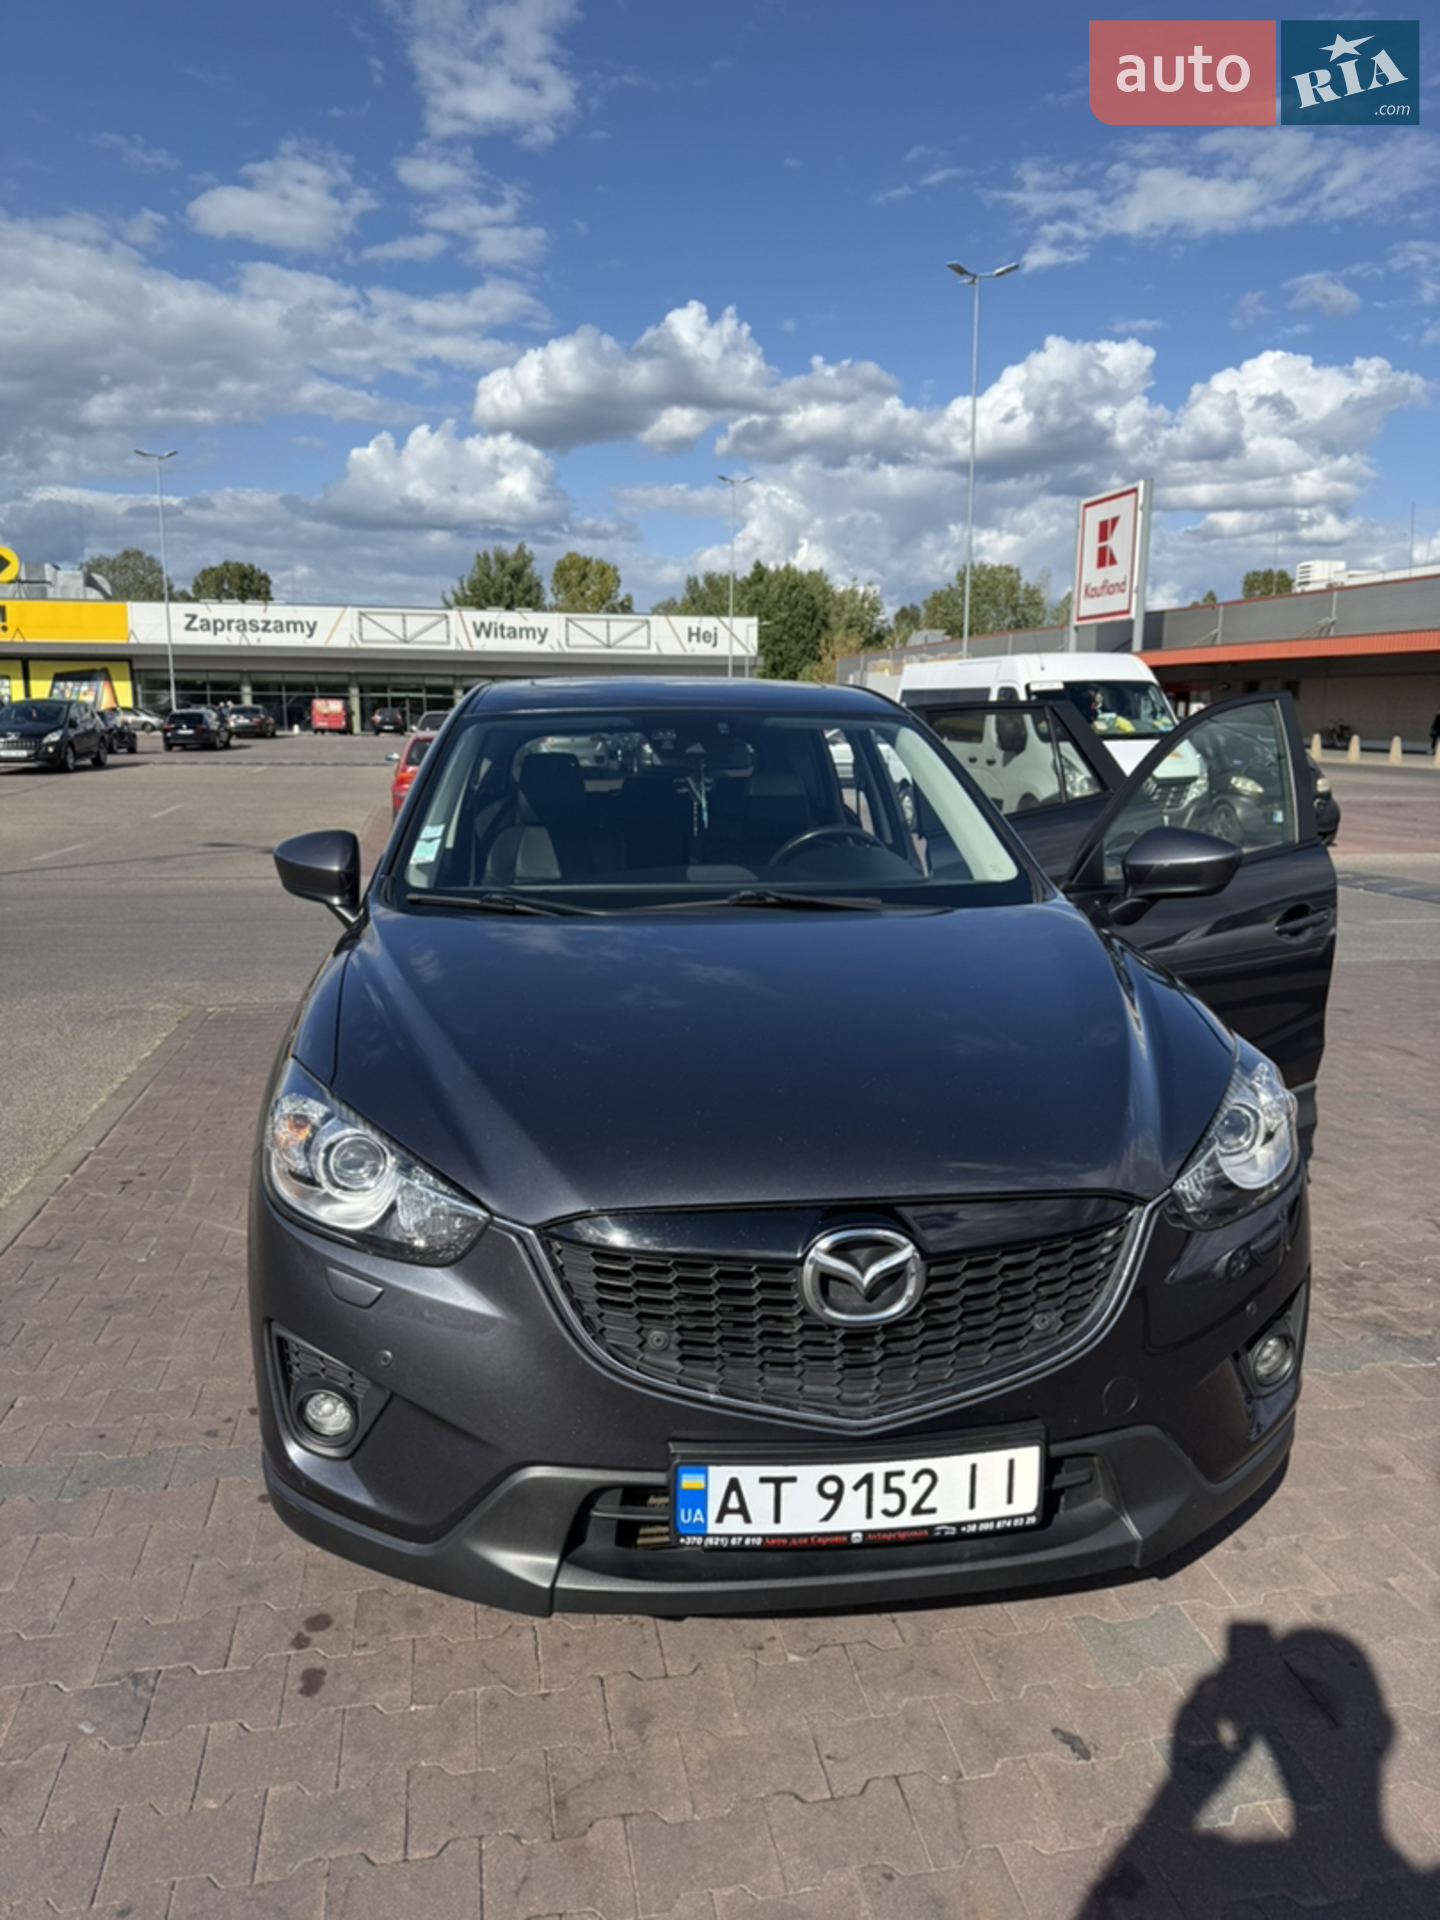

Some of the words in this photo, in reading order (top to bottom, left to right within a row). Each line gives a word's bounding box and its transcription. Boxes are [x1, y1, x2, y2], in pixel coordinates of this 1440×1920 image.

[1083, 576, 1127, 600] Kaufland
[184, 613, 318, 638] Zapraszamy
[472, 620, 549, 645] Witamy
[687, 626, 718, 648] Hej
[714, 1475, 798, 1525] AT
[816, 1467, 939, 1523] 9152
[680, 1508, 705, 1525] UA
[679, 1535, 703, 1546] +370
